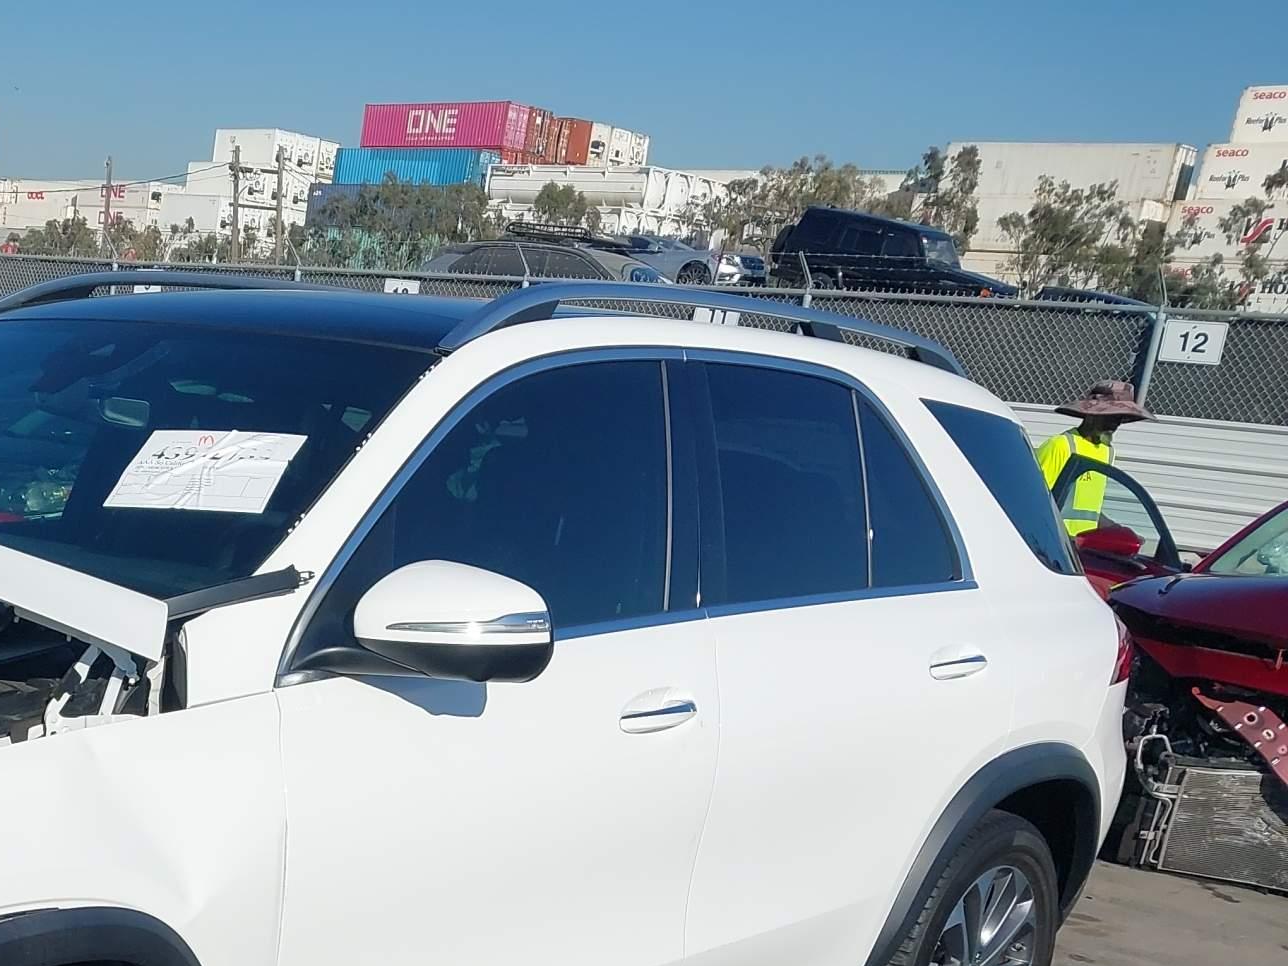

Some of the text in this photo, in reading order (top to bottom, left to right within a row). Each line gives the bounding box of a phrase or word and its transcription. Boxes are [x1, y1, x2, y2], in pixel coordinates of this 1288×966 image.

[1253, 90, 1287, 100] seaco
[407, 108, 459, 134] ONE
[1216, 148, 1249, 158] seaco
[27, 191, 45, 200] OOCL
[1181, 205, 1214, 215] seaco
[1179, 331, 1209, 353] 12
